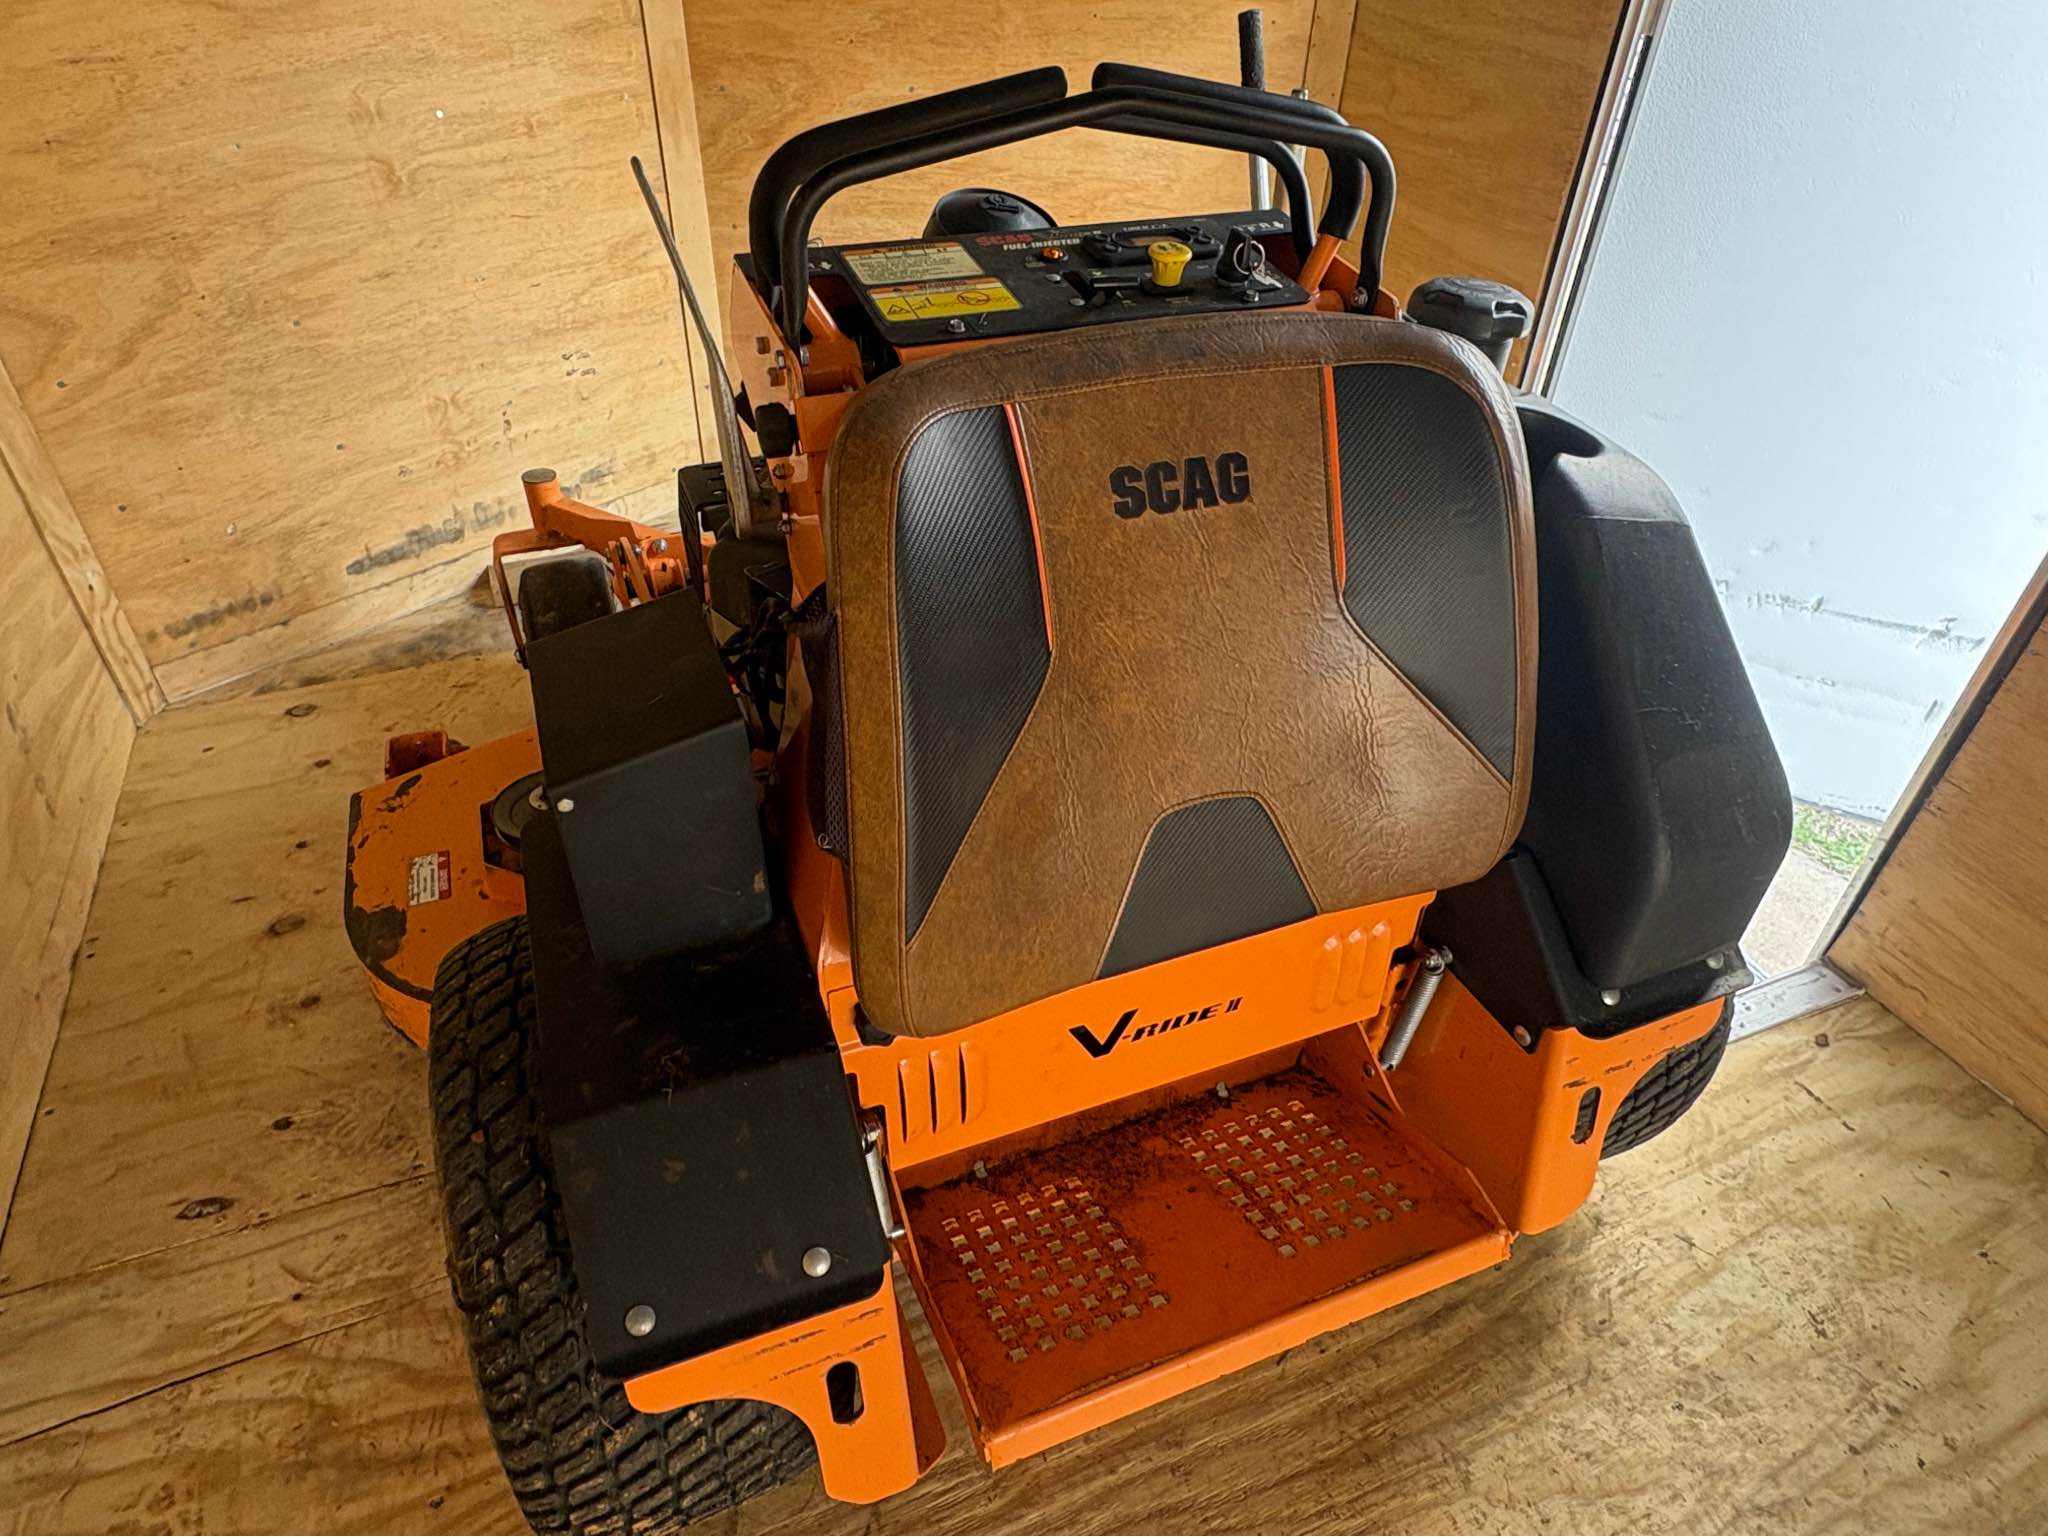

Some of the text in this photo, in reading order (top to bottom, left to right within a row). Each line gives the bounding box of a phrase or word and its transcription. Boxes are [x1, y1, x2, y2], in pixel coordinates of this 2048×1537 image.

[1002, 238, 1081, 251] FUEL-INJECTED
[1109, 451, 1250, 519] SCAG
[1068, 1003, 1222, 1058] V-RIDE
